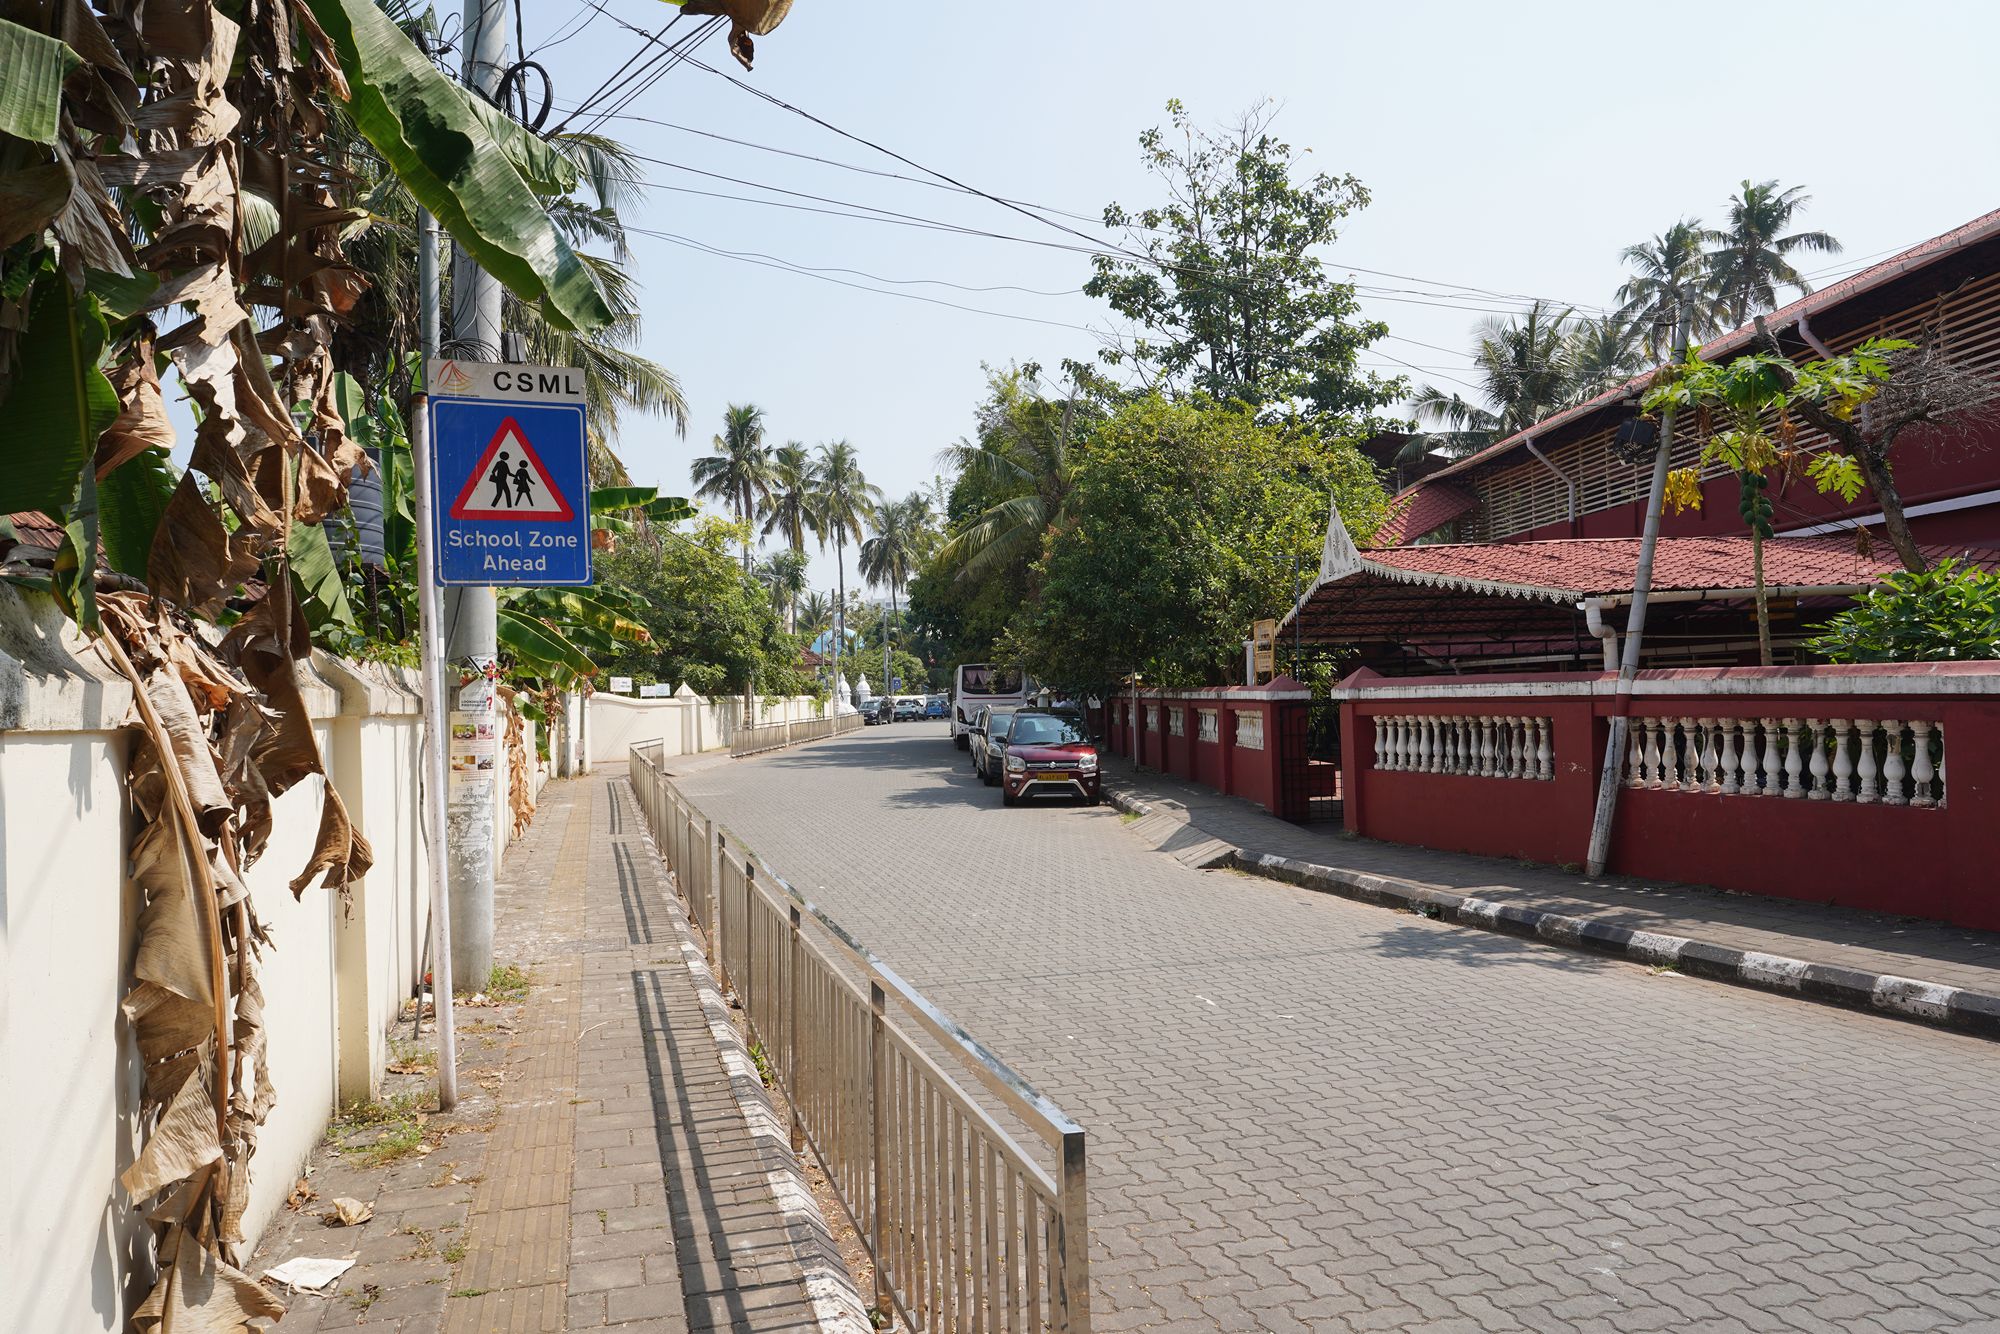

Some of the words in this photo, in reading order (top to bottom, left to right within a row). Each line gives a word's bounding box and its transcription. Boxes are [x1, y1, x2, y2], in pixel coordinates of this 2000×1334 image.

[493, 371, 580, 395] CSML
[448, 529, 522, 549] School
[528, 531, 578, 548] Zone
[482, 555, 547, 572] Ahead
